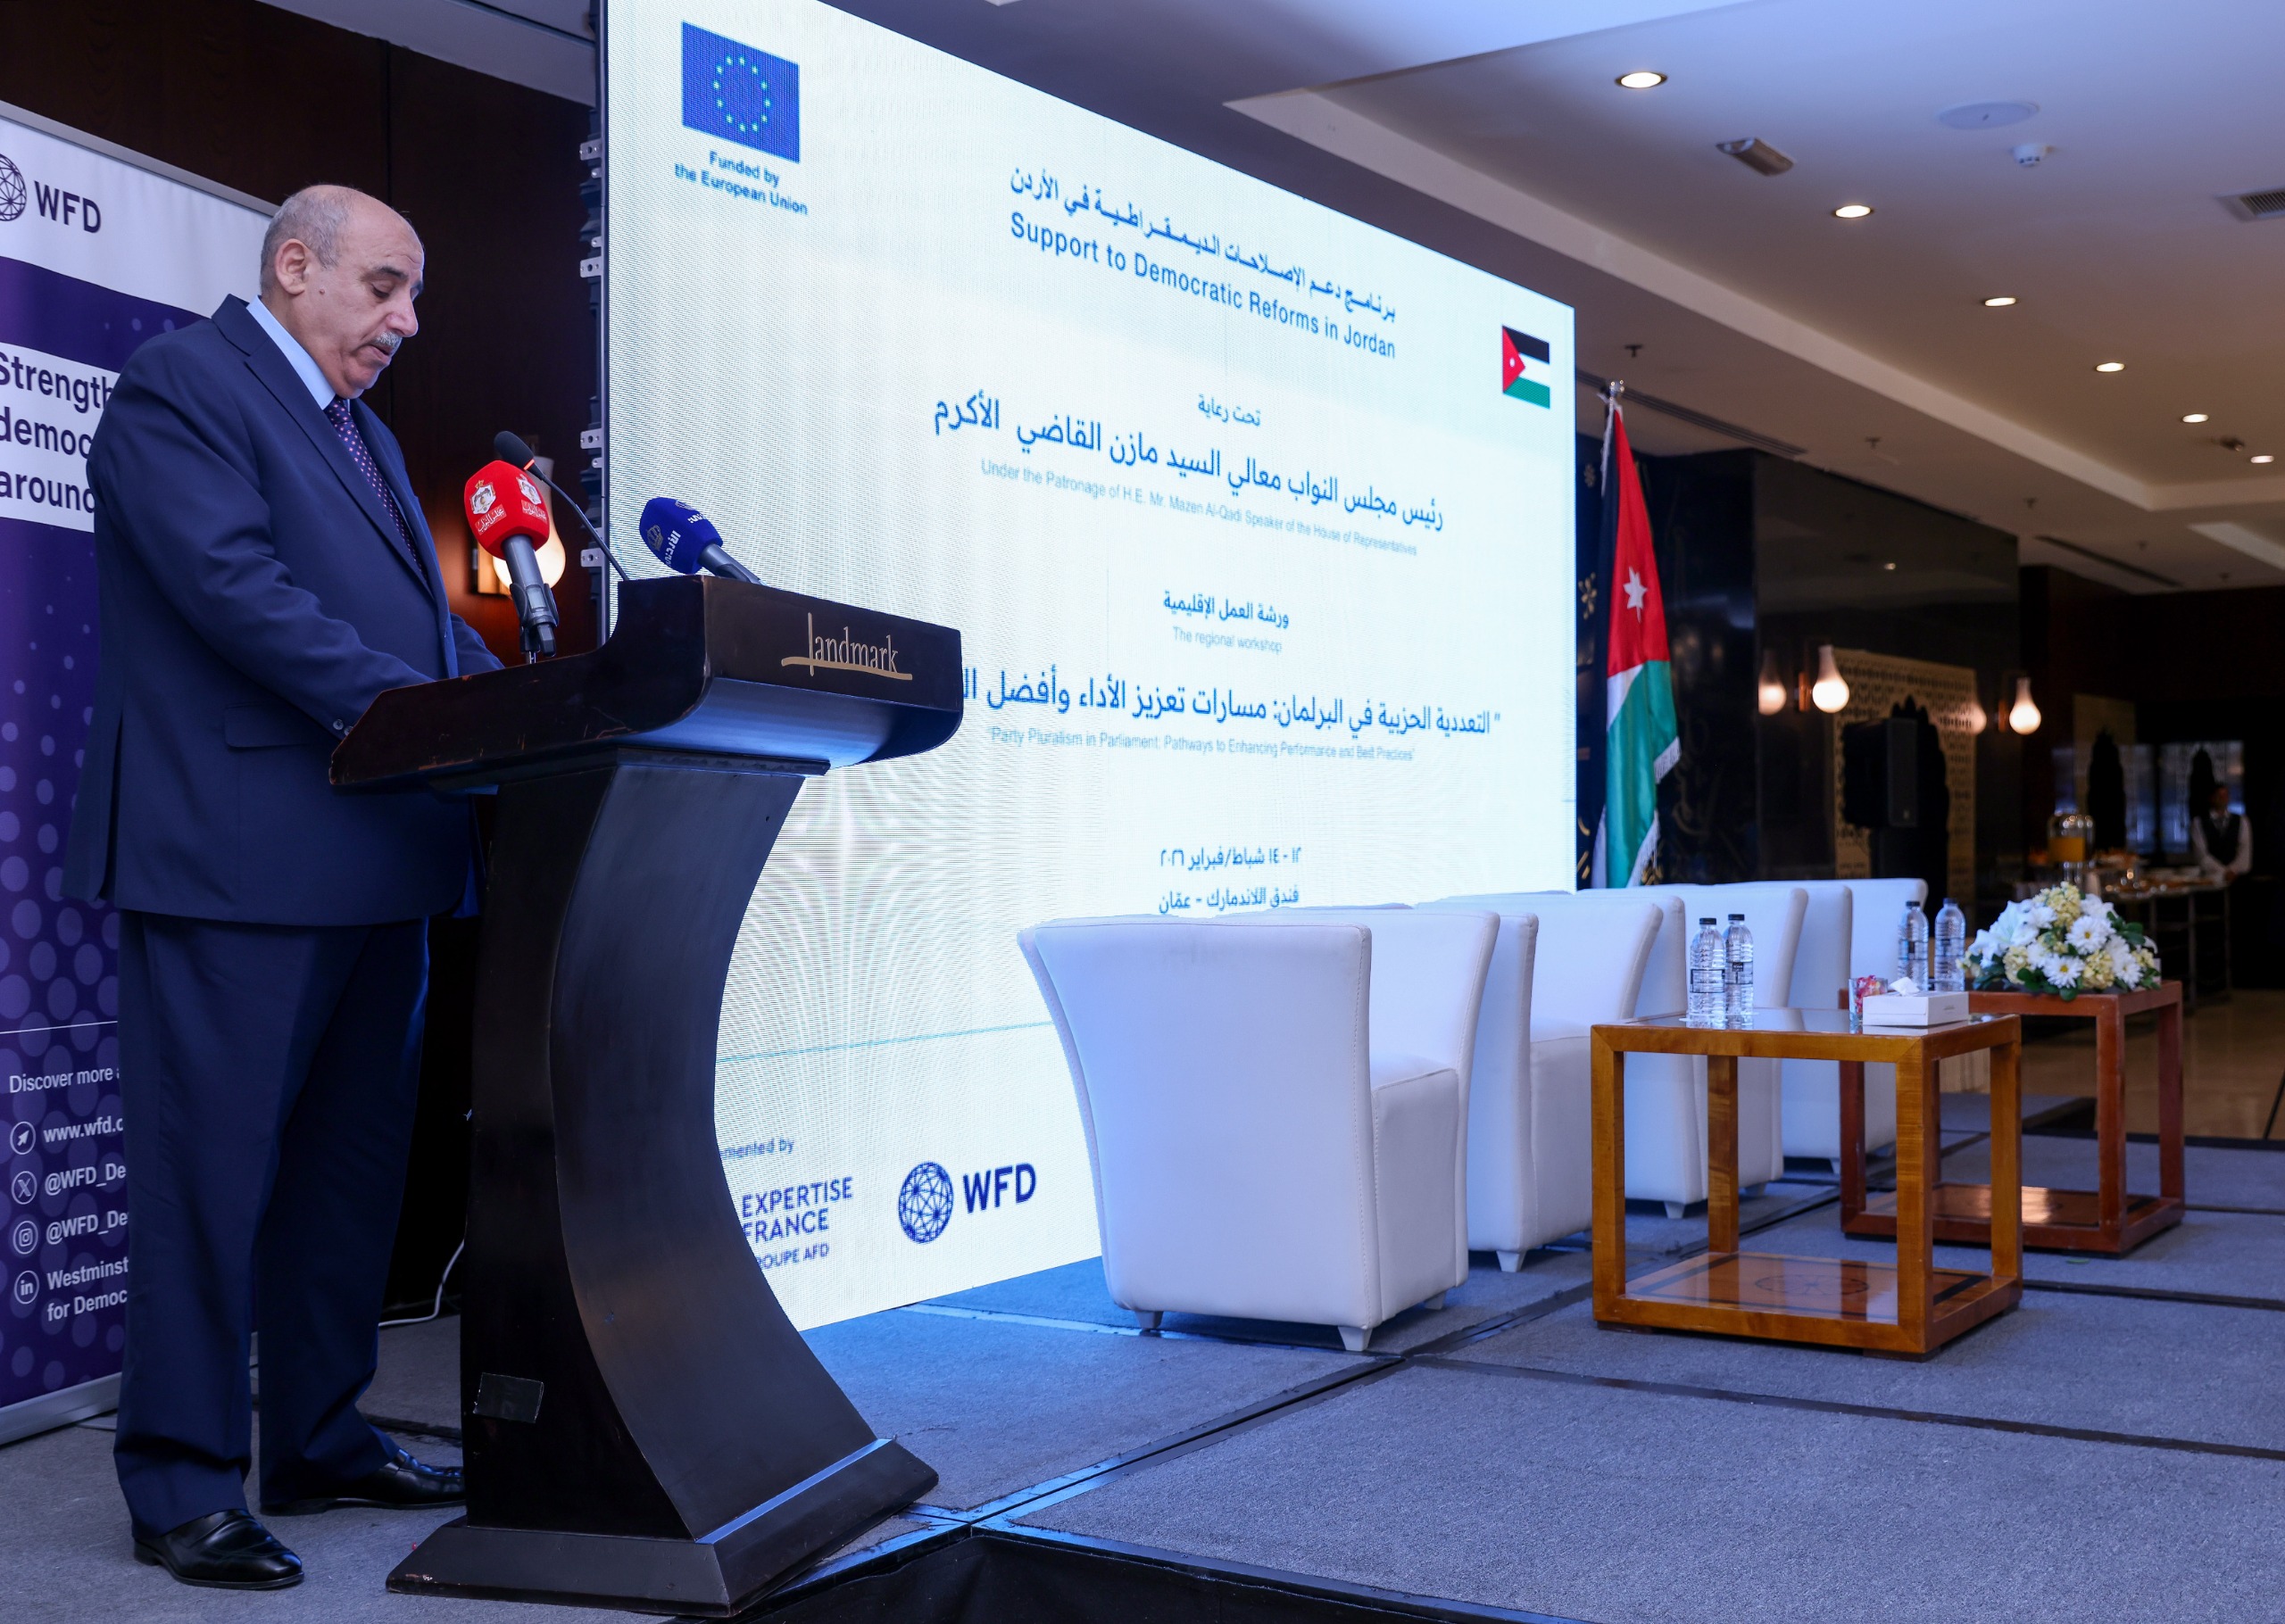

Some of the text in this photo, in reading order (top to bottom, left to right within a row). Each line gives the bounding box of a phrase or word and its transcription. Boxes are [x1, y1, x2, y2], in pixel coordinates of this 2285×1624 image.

[710, 151, 779, 188] Funded by
[1010, 167, 1059, 200] الأردن
[675, 163, 808, 216] the European Union
[1064, 184, 1089, 217] في
[34, 180, 101, 233] WFD
[1010, 211, 1395, 359] Support to Democratic Reforms in Jordan
[1310, 279, 1341, 299] دعم
[1345, 290, 1395, 323] برنامج
[1198, 394, 1260, 427] تحت رعاية
[935, 389, 1443, 531] رئيس مجلس النواب معالي السيد مازن القاضي الأكرم
[982, 458, 1019, 480] Under
[1023, 467, 1043, 485] the
[1046, 471, 1106, 500] Patronage
[1109, 484, 1119, 499] of
[1169, 495, 1204, 514] Mazen
[1246, 510, 1284, 531] Speaker
[1286, 518, 1296, 532] of
[1297, 521, 1311, 535] the
[1314, 524, 1341, 542] House
[1343, 531, 1352, 543] of
[1164, 590, 1289, 629] ورشة العمل الإقليمية
[808, 612, 899, 676] landmark
[1173, 626, 1283, 655] The regional workshop
[986, 664, 1070, 715] وأفضل
[1078, 673, 1126, 708] الأداء
[1132, 686, 1185, 719] تعزيز
[1192, 687, 1267, 723] مسارات
[1349, 699, 1373, 739] في
[1378, 701, 1431, 734] الحزبية
[1435, 707, 1490, 737] التعددية
[1028, 727, 1082, 746] Pluralism
[1086, 730, 1096, 746] in
[1164, 734, 1213, 754] Pathways
[1217, 739, 1226, 752] to
[1228, 739, 1277, 758] Enhancing
[1280, 741, 1336, 758] Performance
[1339, 746, 1354, 758] and
[1207, 886, 1266, 911] اللاندمارك
[1270, 884, 1299, 908] فندق
[9, 1073, 73, 1094] Discover
[77, 1068, 113, 1085] more
[779, 1138, 794, 1154] by
[742, 1176, 852, 1218] EXPERTISE
[962, 1163, 1036, 1214] WFD
[743, 1207, 829, 1243] FRANCE
[804, 1243, 829, 1260] AFD
[46, 1256, 129, 1290] Westminst
[46, 1289, 128, 1322] for Democ
